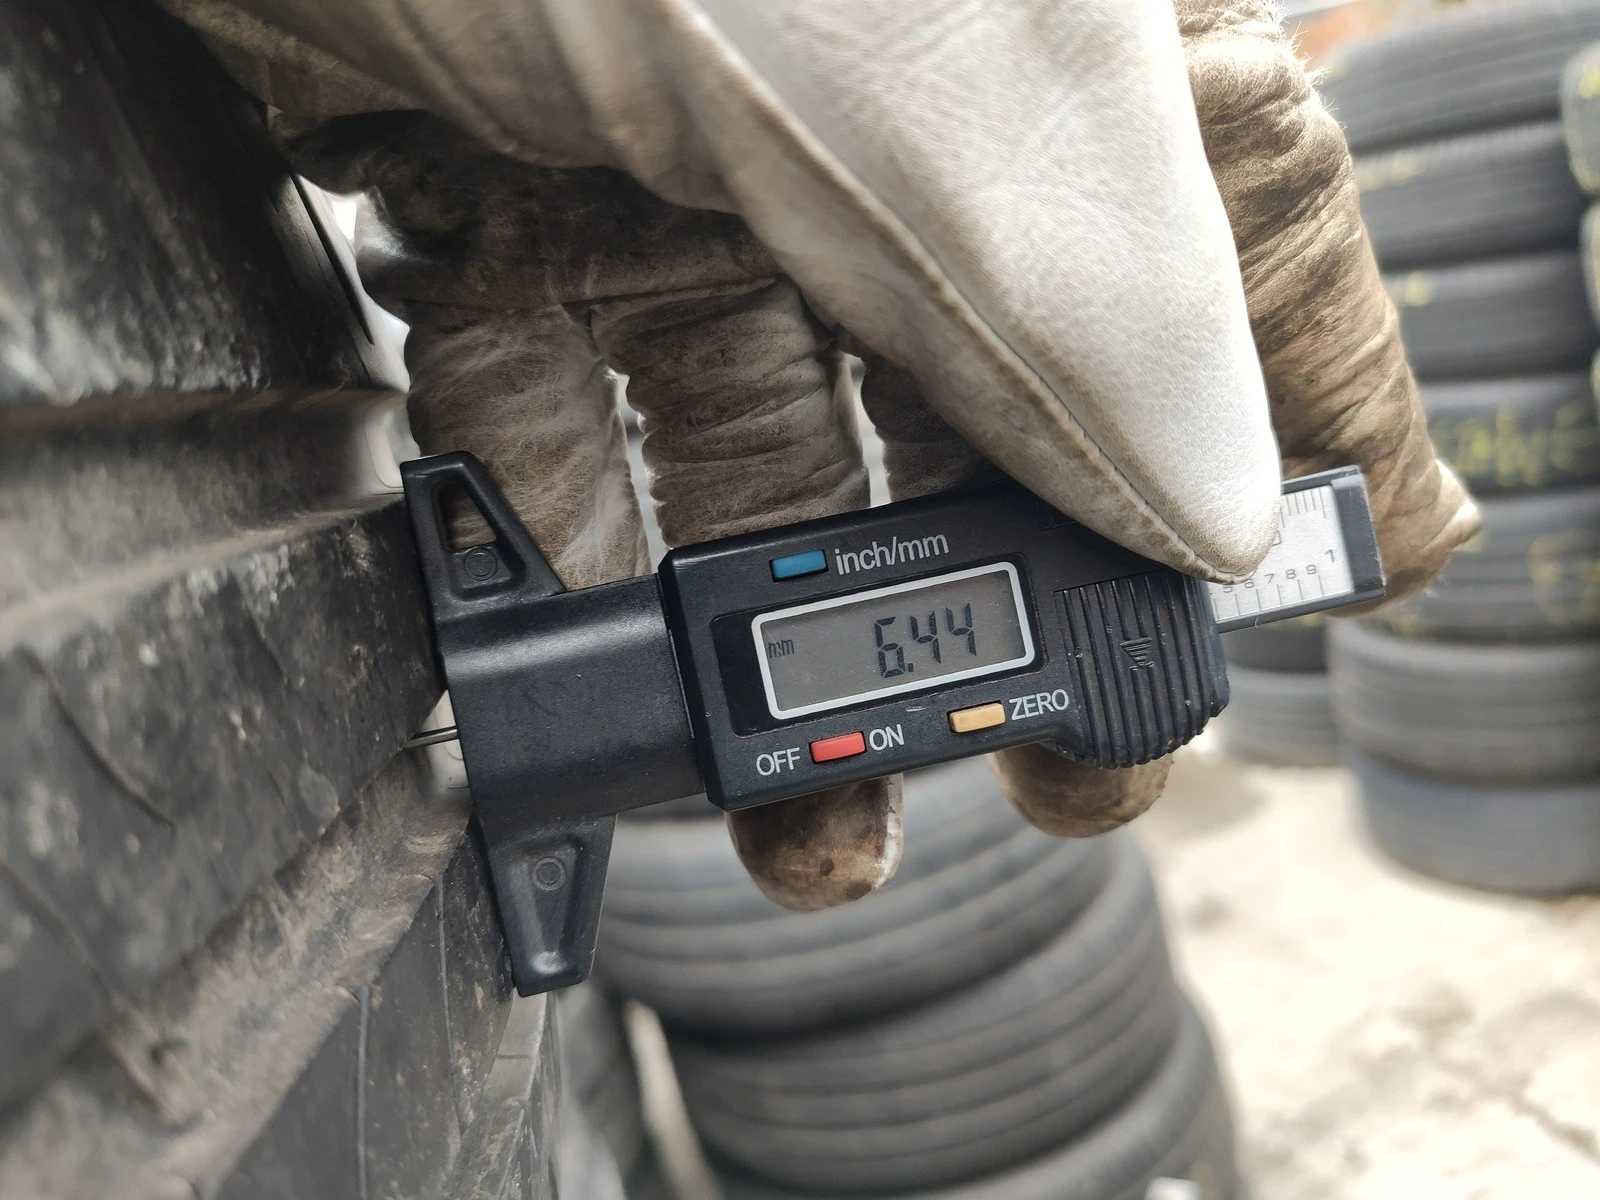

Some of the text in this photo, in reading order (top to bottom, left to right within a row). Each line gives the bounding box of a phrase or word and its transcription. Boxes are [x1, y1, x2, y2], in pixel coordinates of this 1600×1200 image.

[835, 533, 949, 575] inch/mm
[1324, 549, 1335, 563] 1
[1264, 573, 1275, 584] 7
[1286, 568, 1296, 580] 8
[1306, 564, 1317, 575] 9
[767, 602, 977, 678] mm 6.44
[1009, 688, 1069, 721] ZERO
[869, 724, 904, 751] ON
[756, 747, 801, 776] OFF
